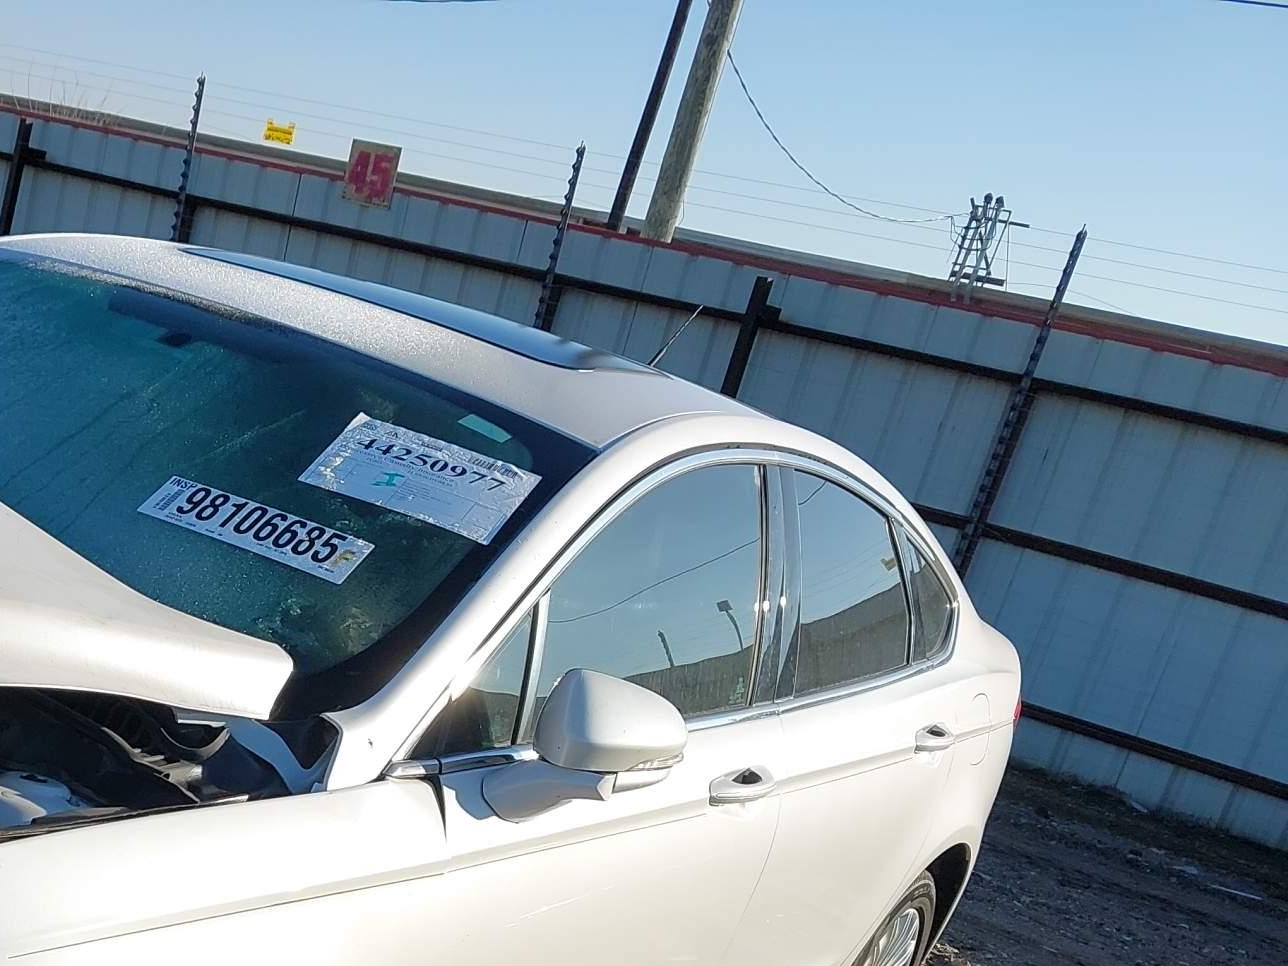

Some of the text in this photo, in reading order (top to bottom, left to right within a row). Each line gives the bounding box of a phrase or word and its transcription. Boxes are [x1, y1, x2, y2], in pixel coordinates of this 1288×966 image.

[347, 150, 396, 201] 45
[169, 476, 198, 491] INSP
[356, 437, 506, 492] 44250977
[175, 486, 348, 564] 98106685
